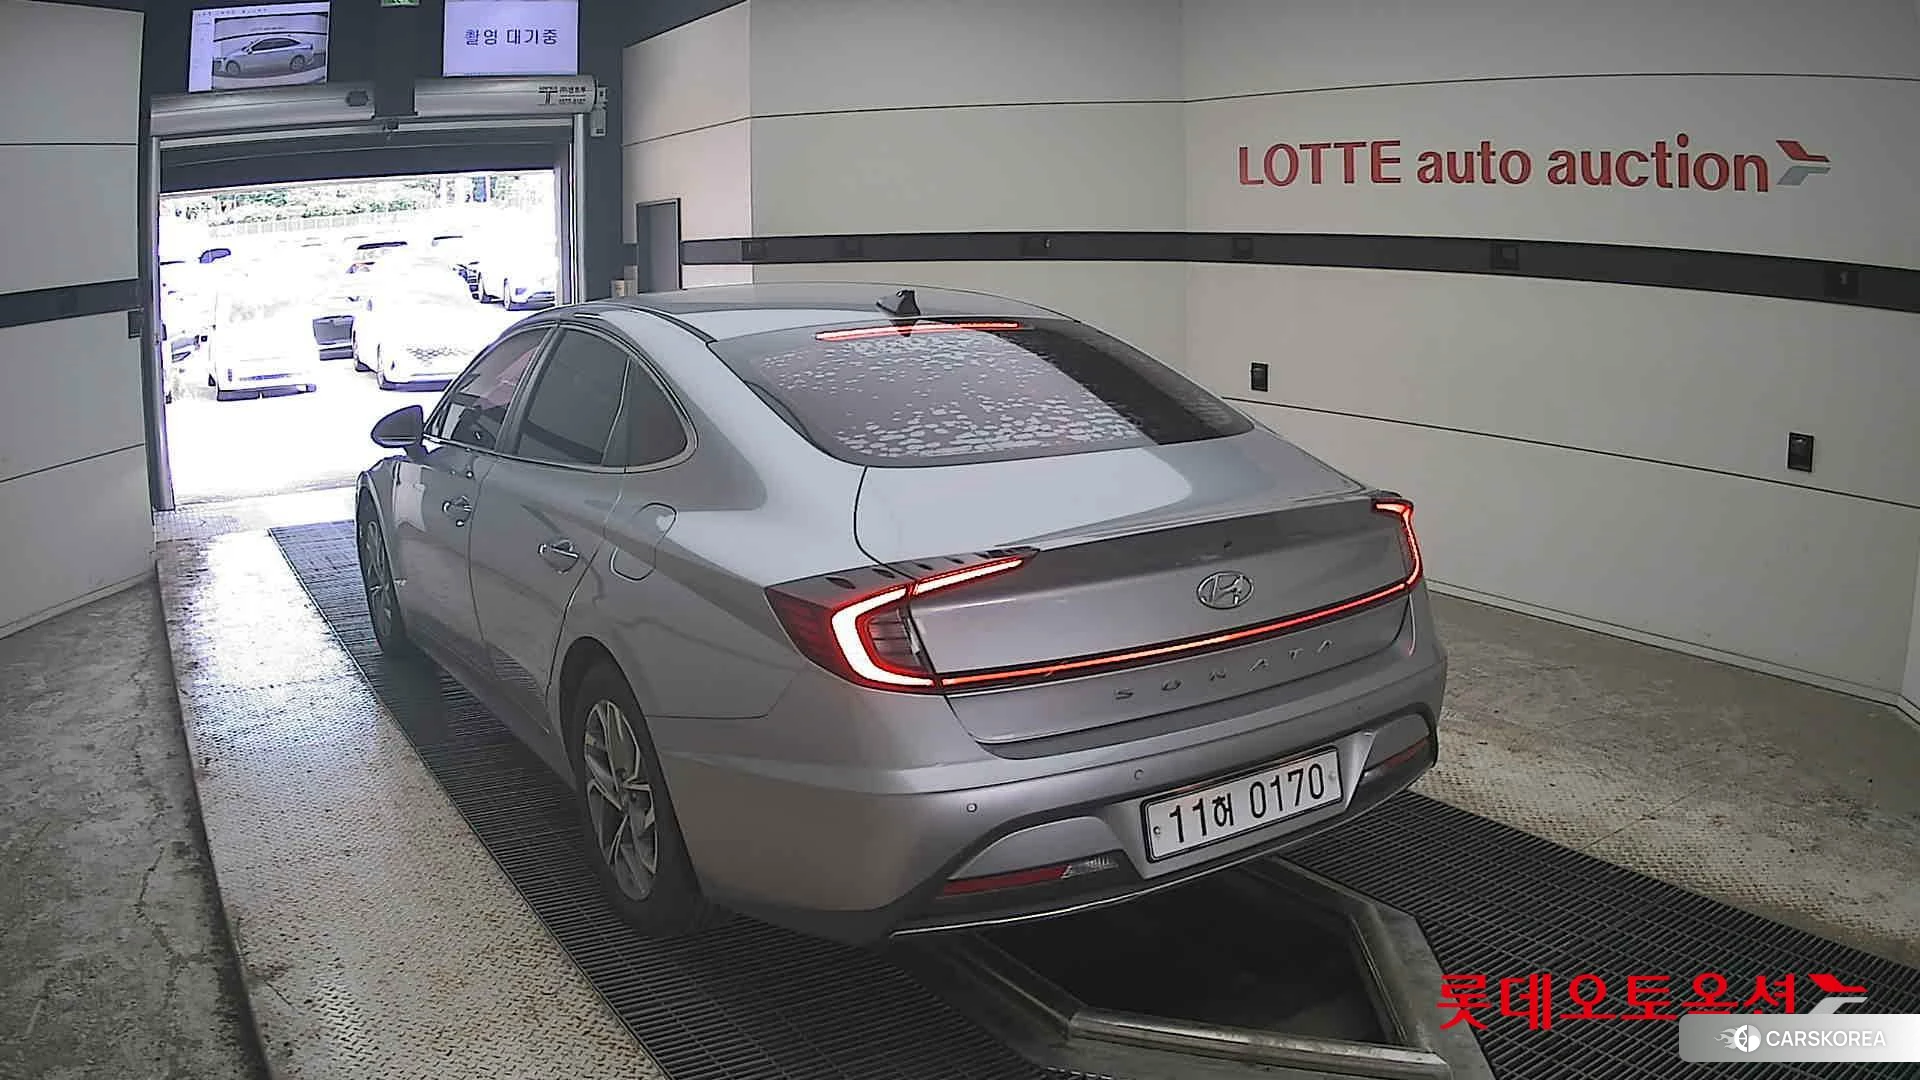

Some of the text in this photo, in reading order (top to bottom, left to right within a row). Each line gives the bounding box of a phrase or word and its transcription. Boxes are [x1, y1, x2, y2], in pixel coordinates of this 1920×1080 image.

[506, 28, 558, 46] 대기중
[1238, 133, 1769, 193] LOTTE auto auction
[1114, 639, 1333, 700] SONATA
[1168, 763, 1325, 844] 11허 0170
